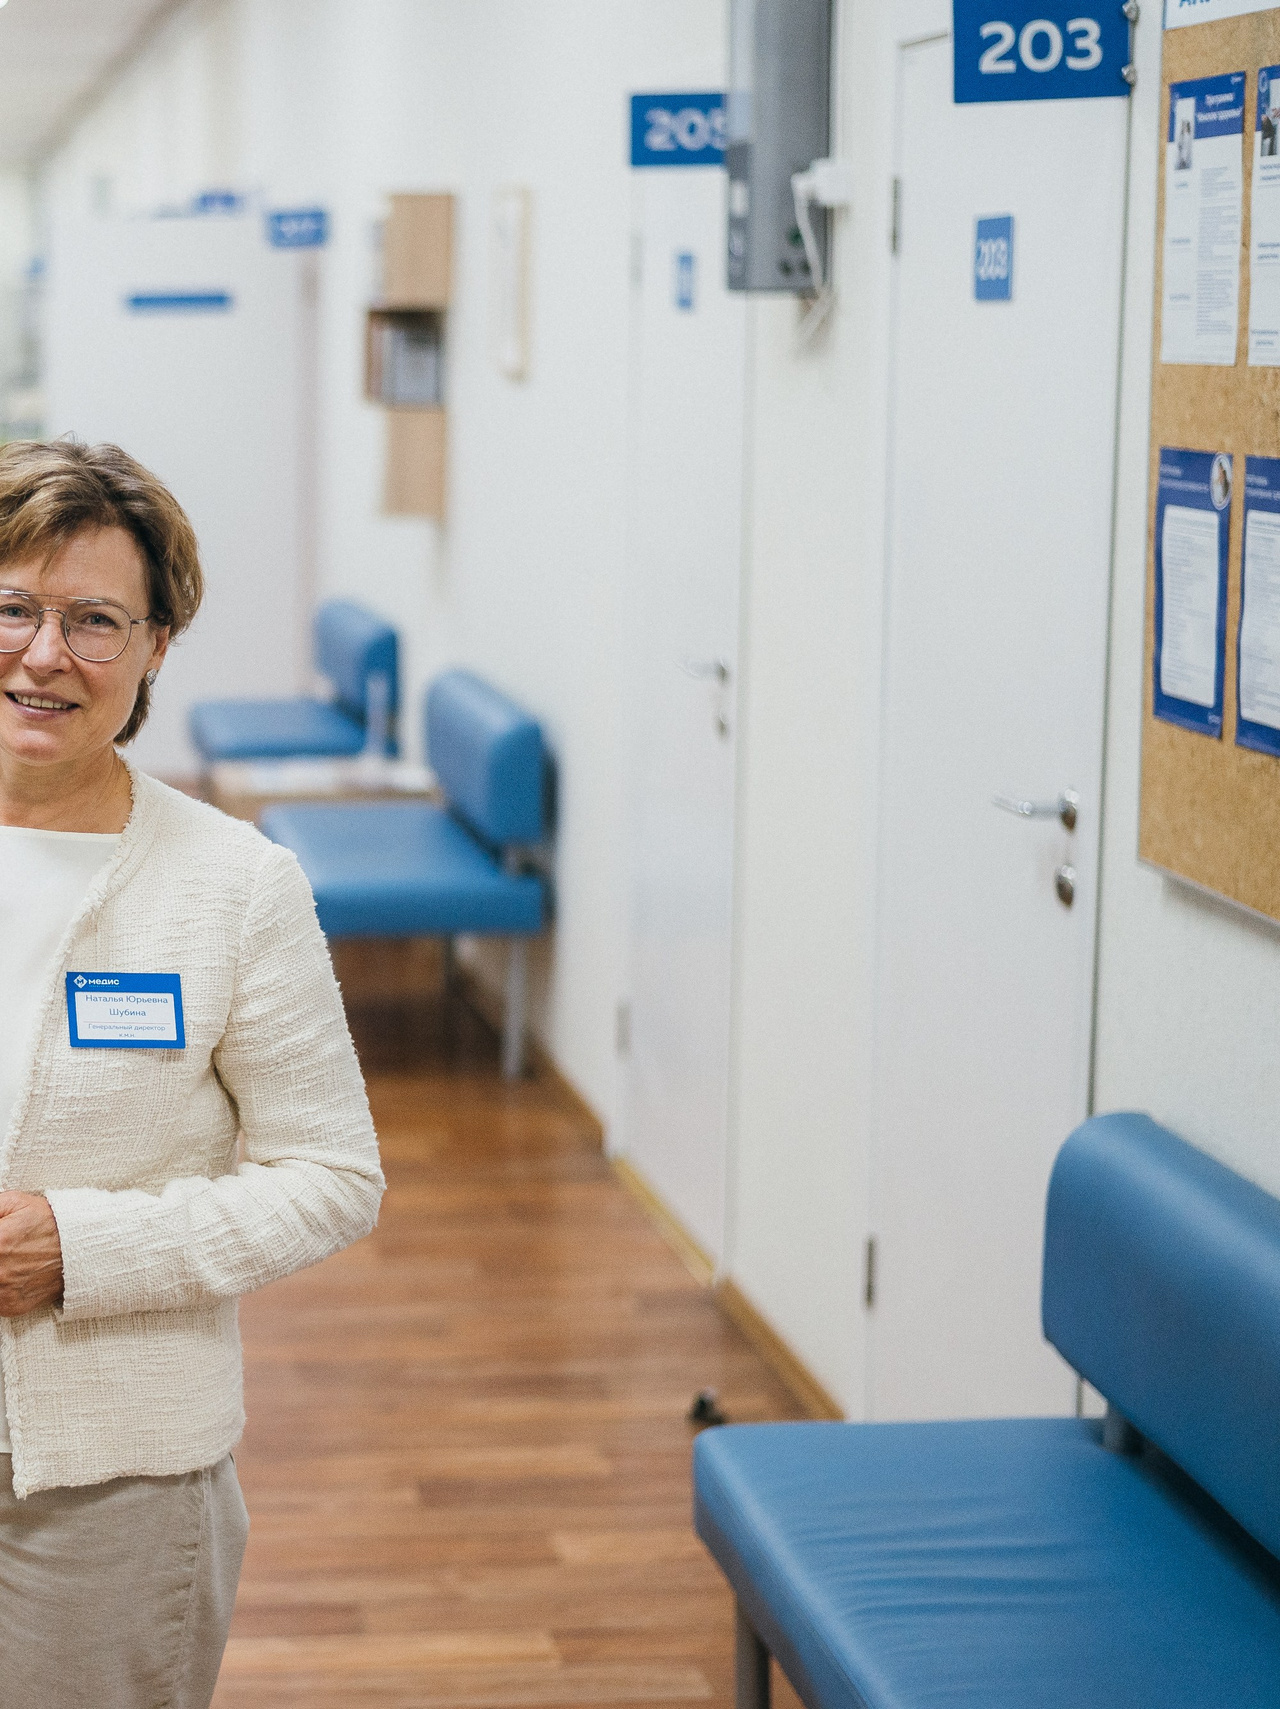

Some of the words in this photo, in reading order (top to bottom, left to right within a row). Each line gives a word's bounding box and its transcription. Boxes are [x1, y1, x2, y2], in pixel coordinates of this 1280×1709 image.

[978, 17, 1103, 75] 203
[85, 994, 124, 1003] Наталья
[126, 995, 168, 1004] Юрьевна
[109, 1008, 146, 1017] Шубина
[88, 1023, 133, 1031] Генеральный
